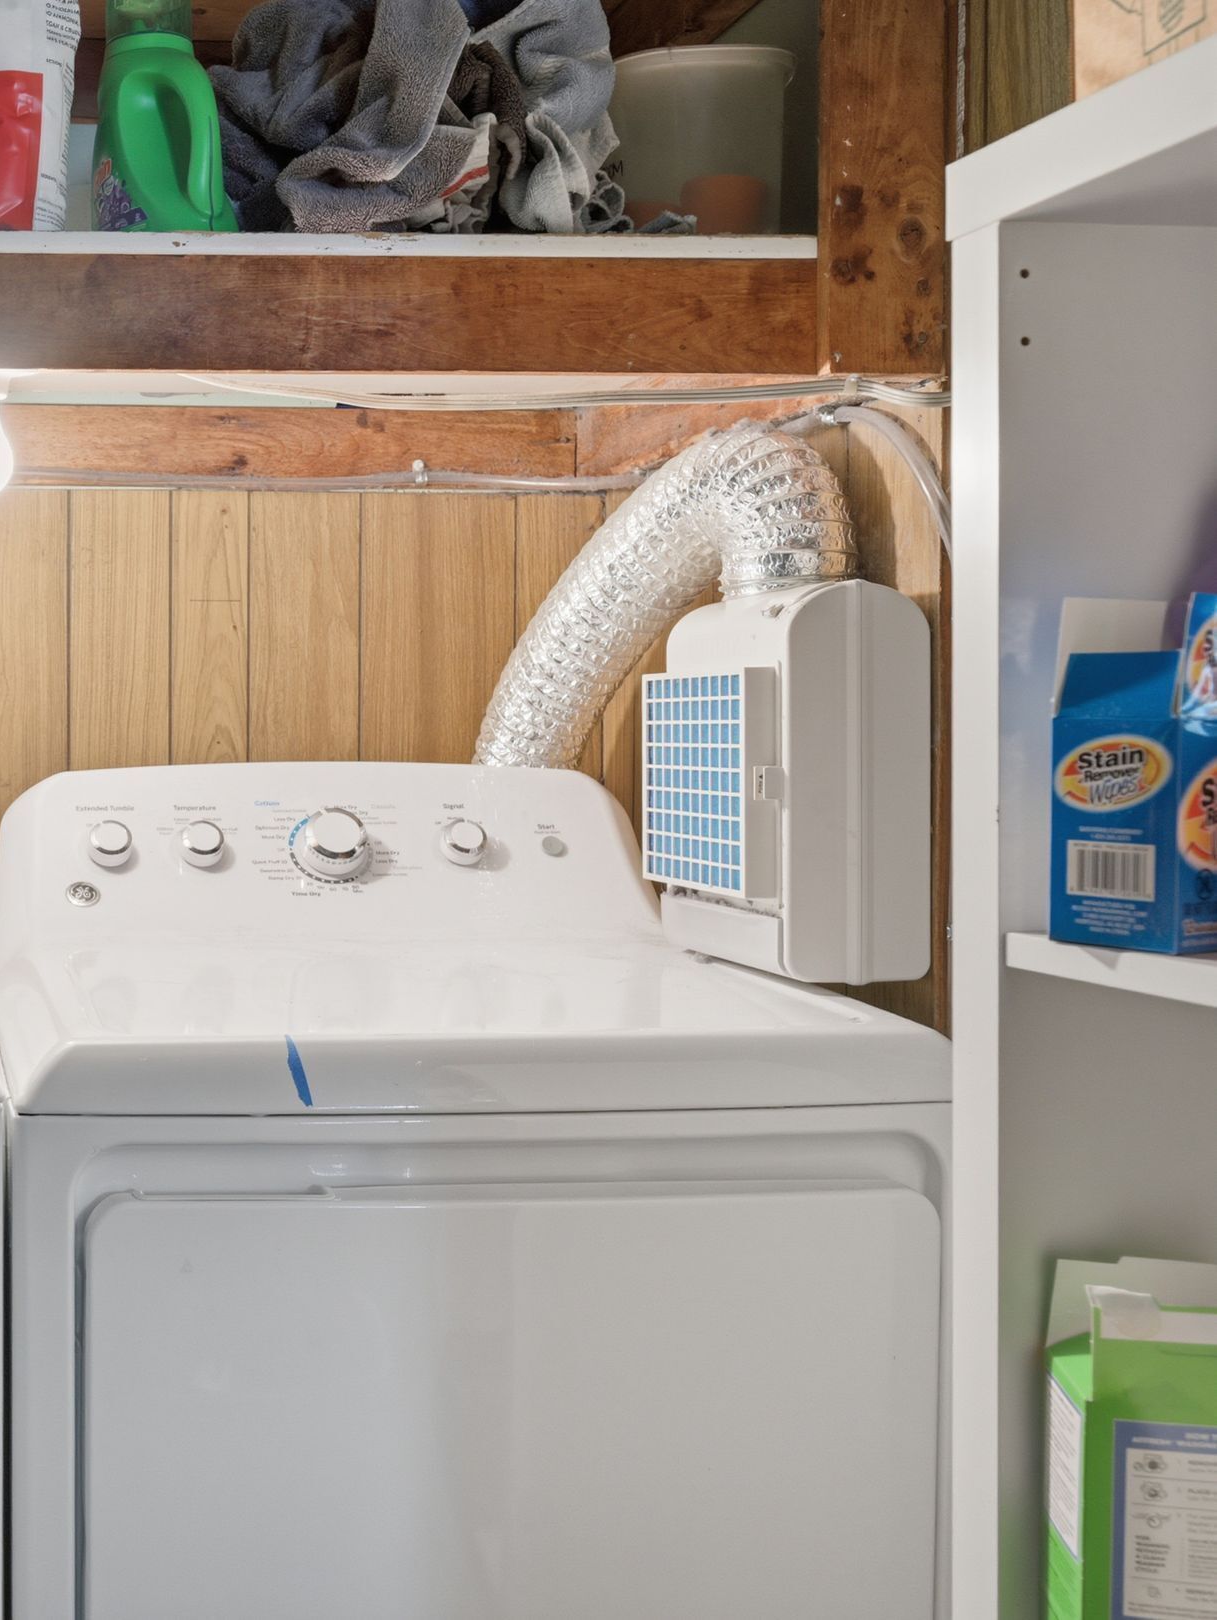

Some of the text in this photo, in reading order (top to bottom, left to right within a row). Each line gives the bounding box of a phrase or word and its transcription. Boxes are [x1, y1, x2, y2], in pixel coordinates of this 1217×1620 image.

[1078, 746, 1144, 770] Stain
[1084, 767, 1140, 783] Remover
[1090, 780, 1138, 804] Wipes
